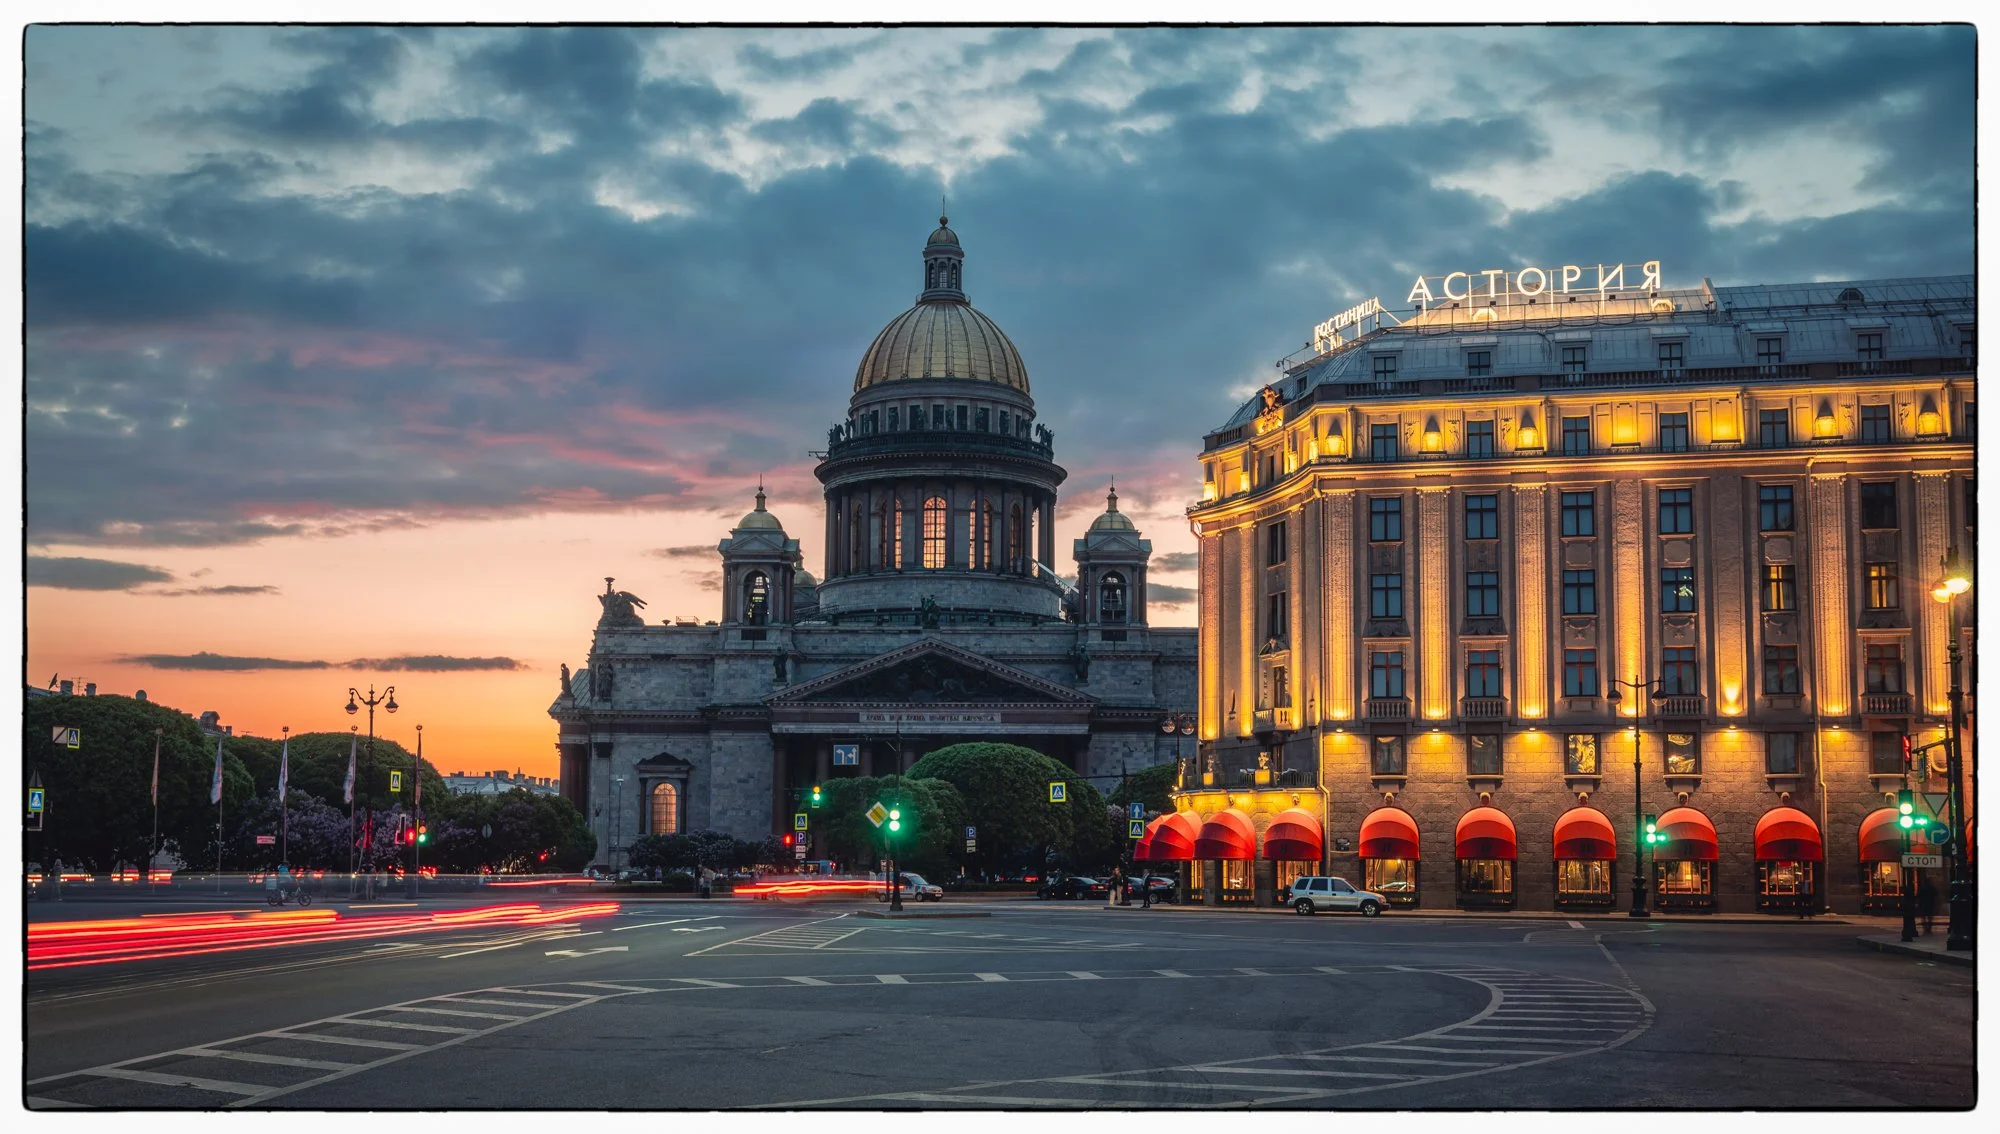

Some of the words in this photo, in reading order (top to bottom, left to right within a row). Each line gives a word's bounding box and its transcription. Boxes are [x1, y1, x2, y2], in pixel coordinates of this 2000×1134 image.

[1407, 261, 1661, 302] АСТОРИЯ
[1314, 296, 1380, 337] ГОСТИНИЦА
[1907, 857, 1936, 865] СТОП
